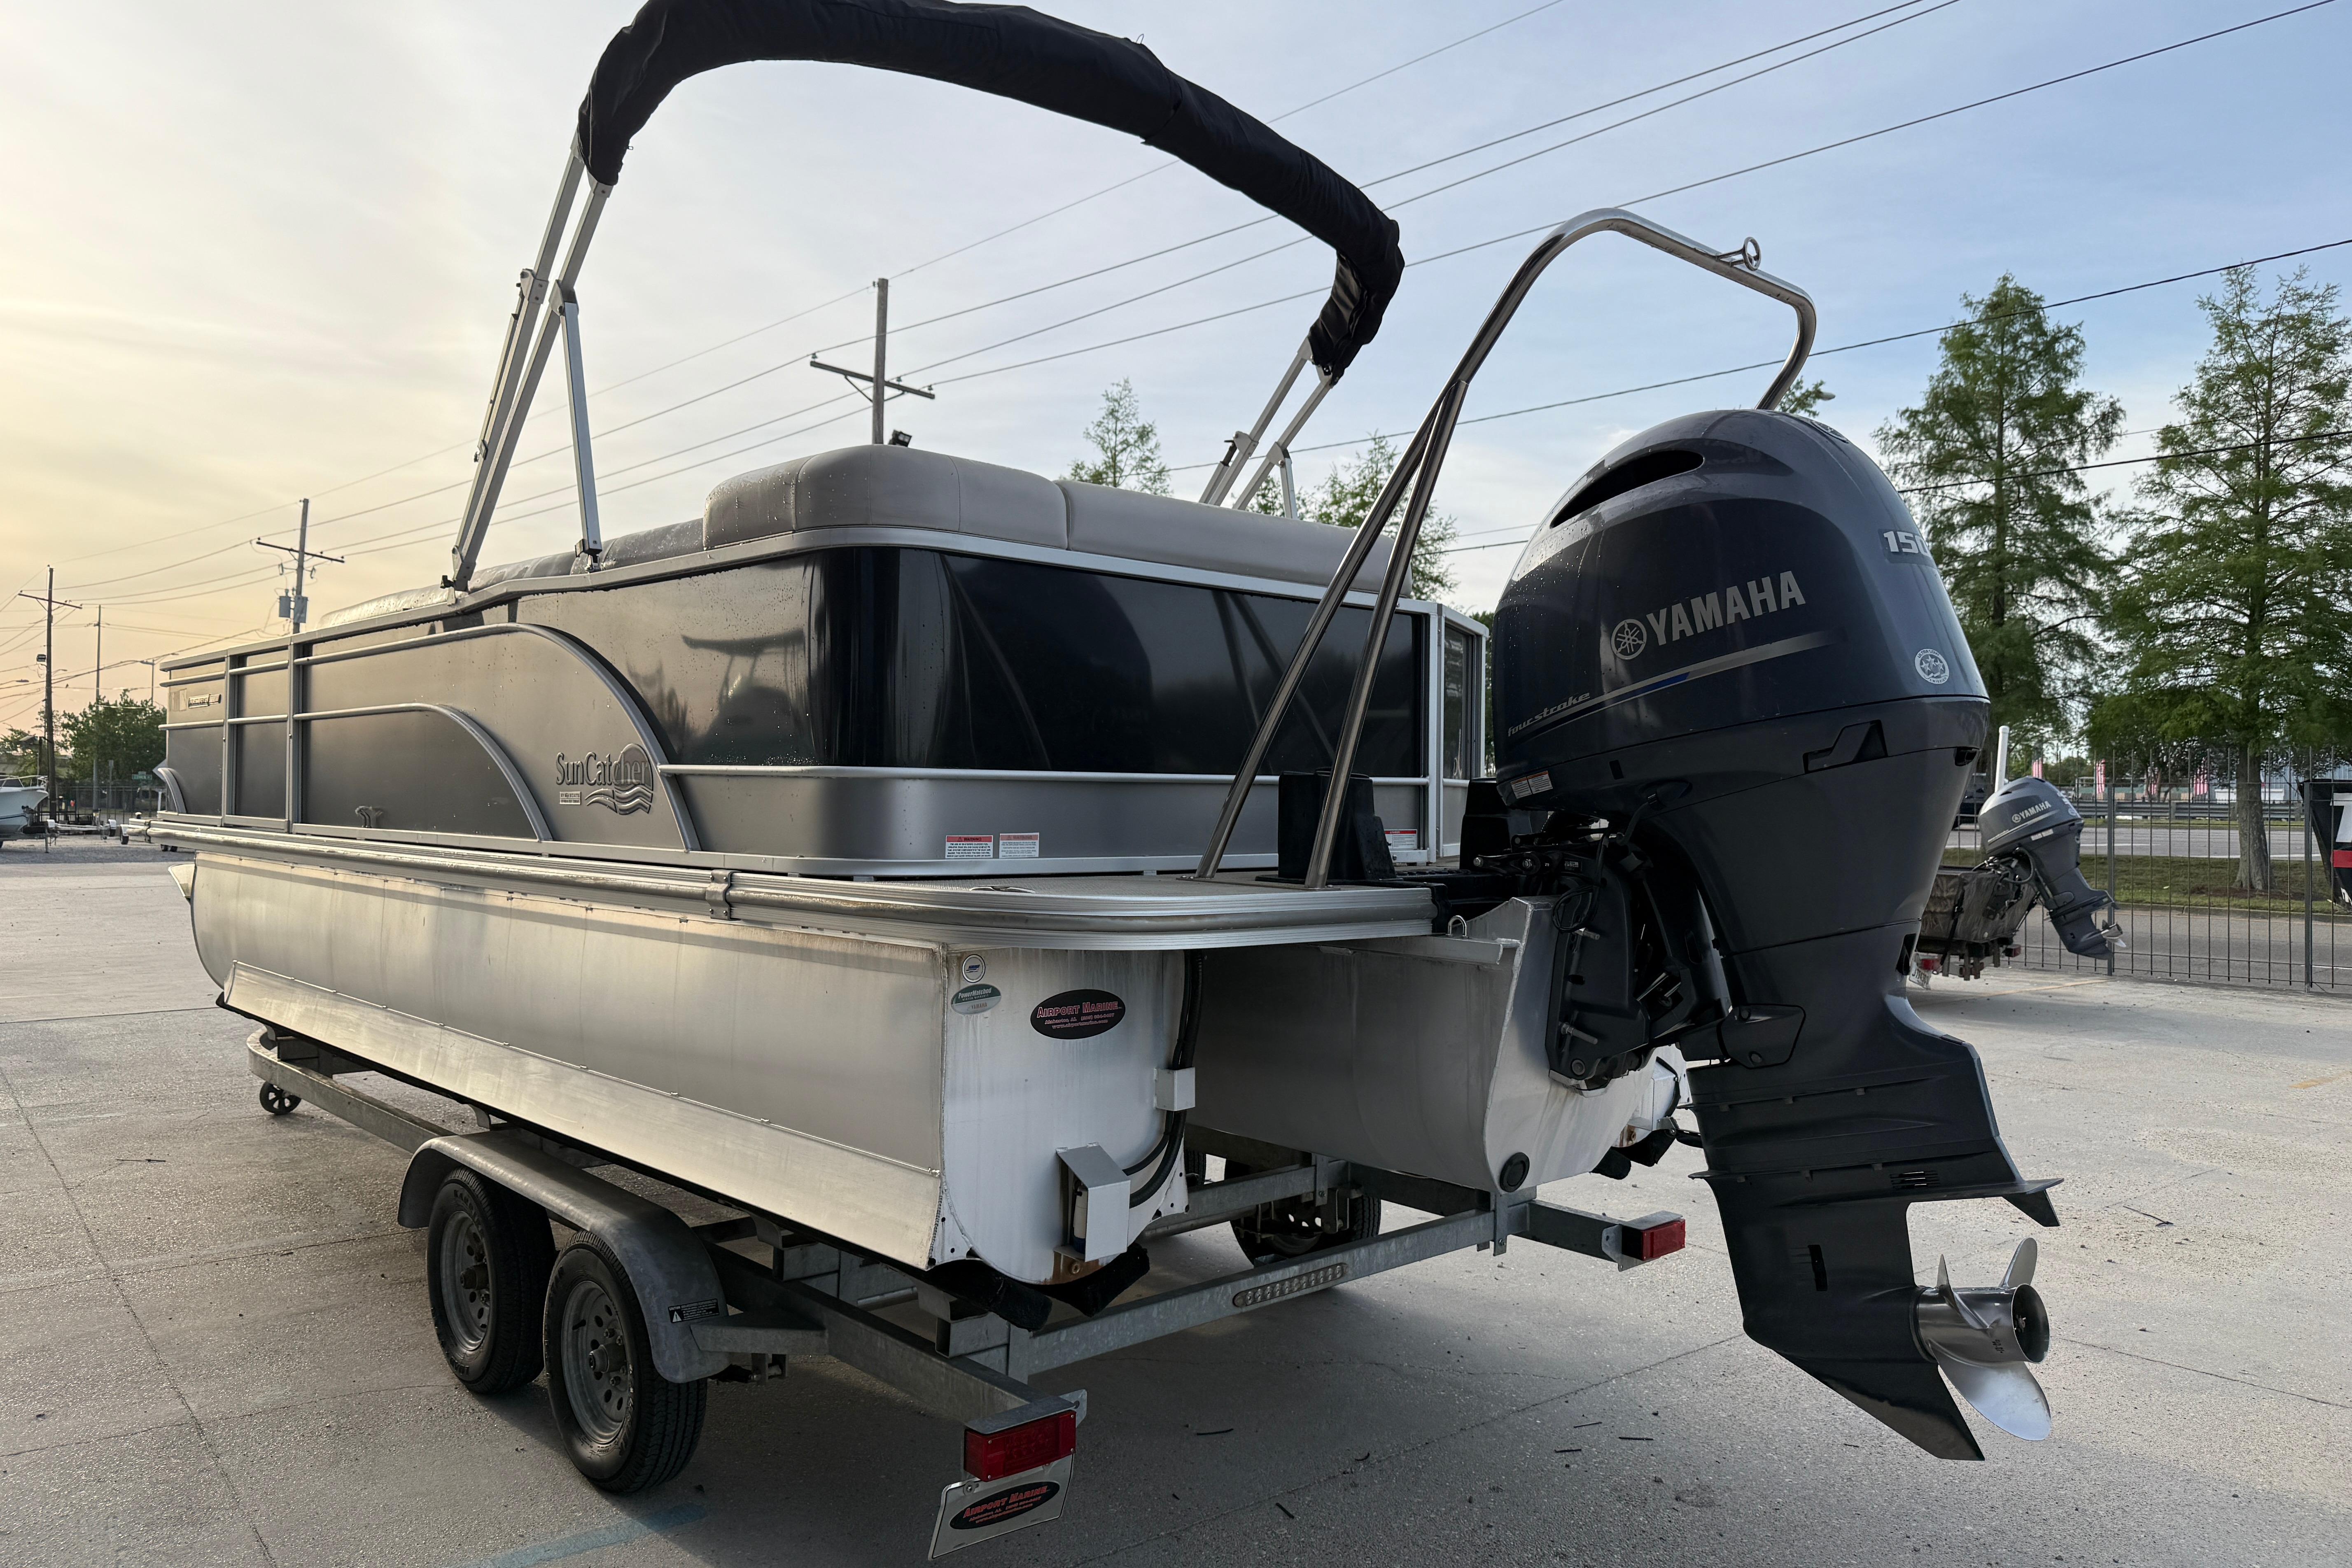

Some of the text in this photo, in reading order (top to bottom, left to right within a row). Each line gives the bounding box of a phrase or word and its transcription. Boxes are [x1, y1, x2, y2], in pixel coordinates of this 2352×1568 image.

[1647, 570, 1806, 646] YAMAHA
[556, 751, 648, 786] SunCatcher
[2019, 800, 2052, 819] YAMAHA
